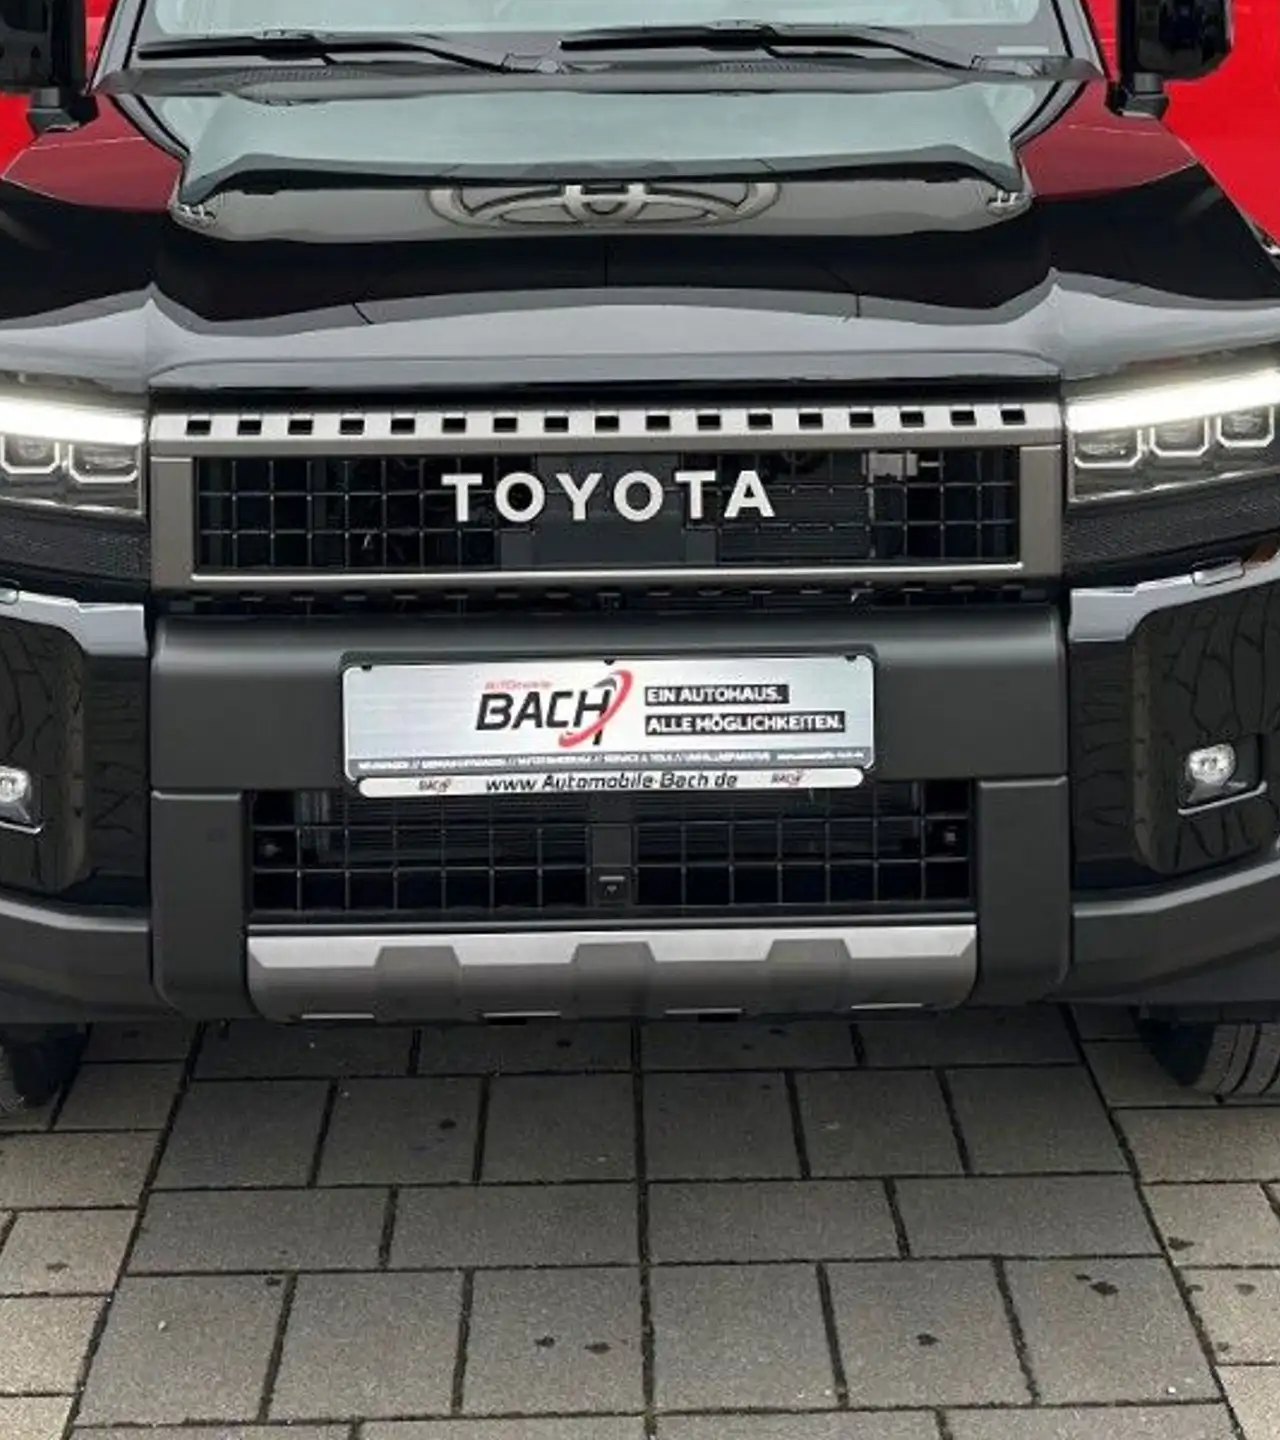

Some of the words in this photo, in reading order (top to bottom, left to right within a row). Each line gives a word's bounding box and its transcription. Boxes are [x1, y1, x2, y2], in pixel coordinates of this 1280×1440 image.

[441, 470, 776, 523] TOYOTA
[647, 688, 676, 703] EIN
[679, 686, 782, 702] AUTOHAUS.
[476, 687, 616, 747] BACH
[648, 720, 693, 734] ALLE
[696, 713, 843, 733] MÖGLICHKEITEN.
